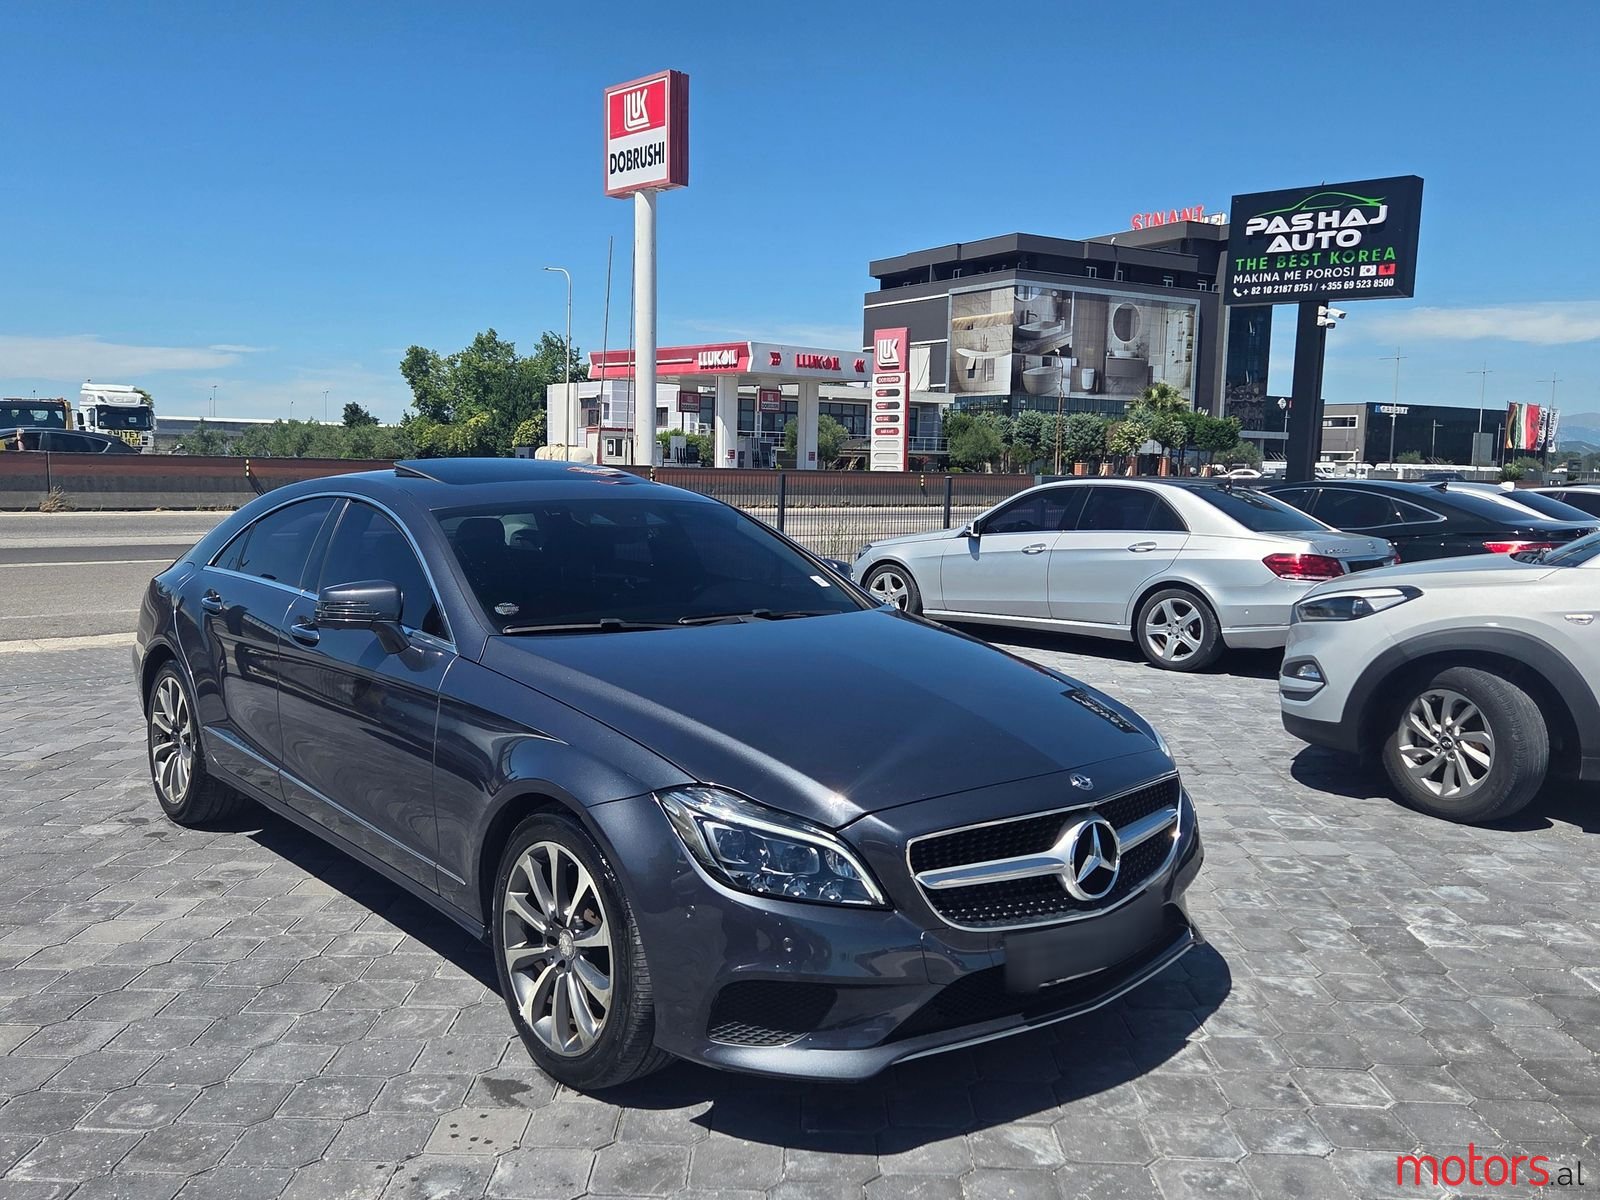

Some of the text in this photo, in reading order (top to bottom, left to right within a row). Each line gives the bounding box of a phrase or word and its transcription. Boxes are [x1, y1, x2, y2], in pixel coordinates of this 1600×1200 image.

[610, 141, 665, 174] DOBRUSHI
[1245, 204, 1388, 236] PASHAJ
[1265, 229, 1362, 253] AUTO
[1235, 247, 1396, 271] THE BEST KOREA
[1233, 267, 1355, 284] MAKINA ME POROSI
[1251, 285, 1261, 294] 82
[1263, 285, 1272, 294] 10
[1273, 284, 1292, 293] 2187
[1294, 283, 1313, 292] 8751
[1320, 281, 1342, 290] +355
[1344, 280, 1354, 289] 69
[1356, 279, 1371, 288] 523
[1373, 278, 1394, 287] 8500
